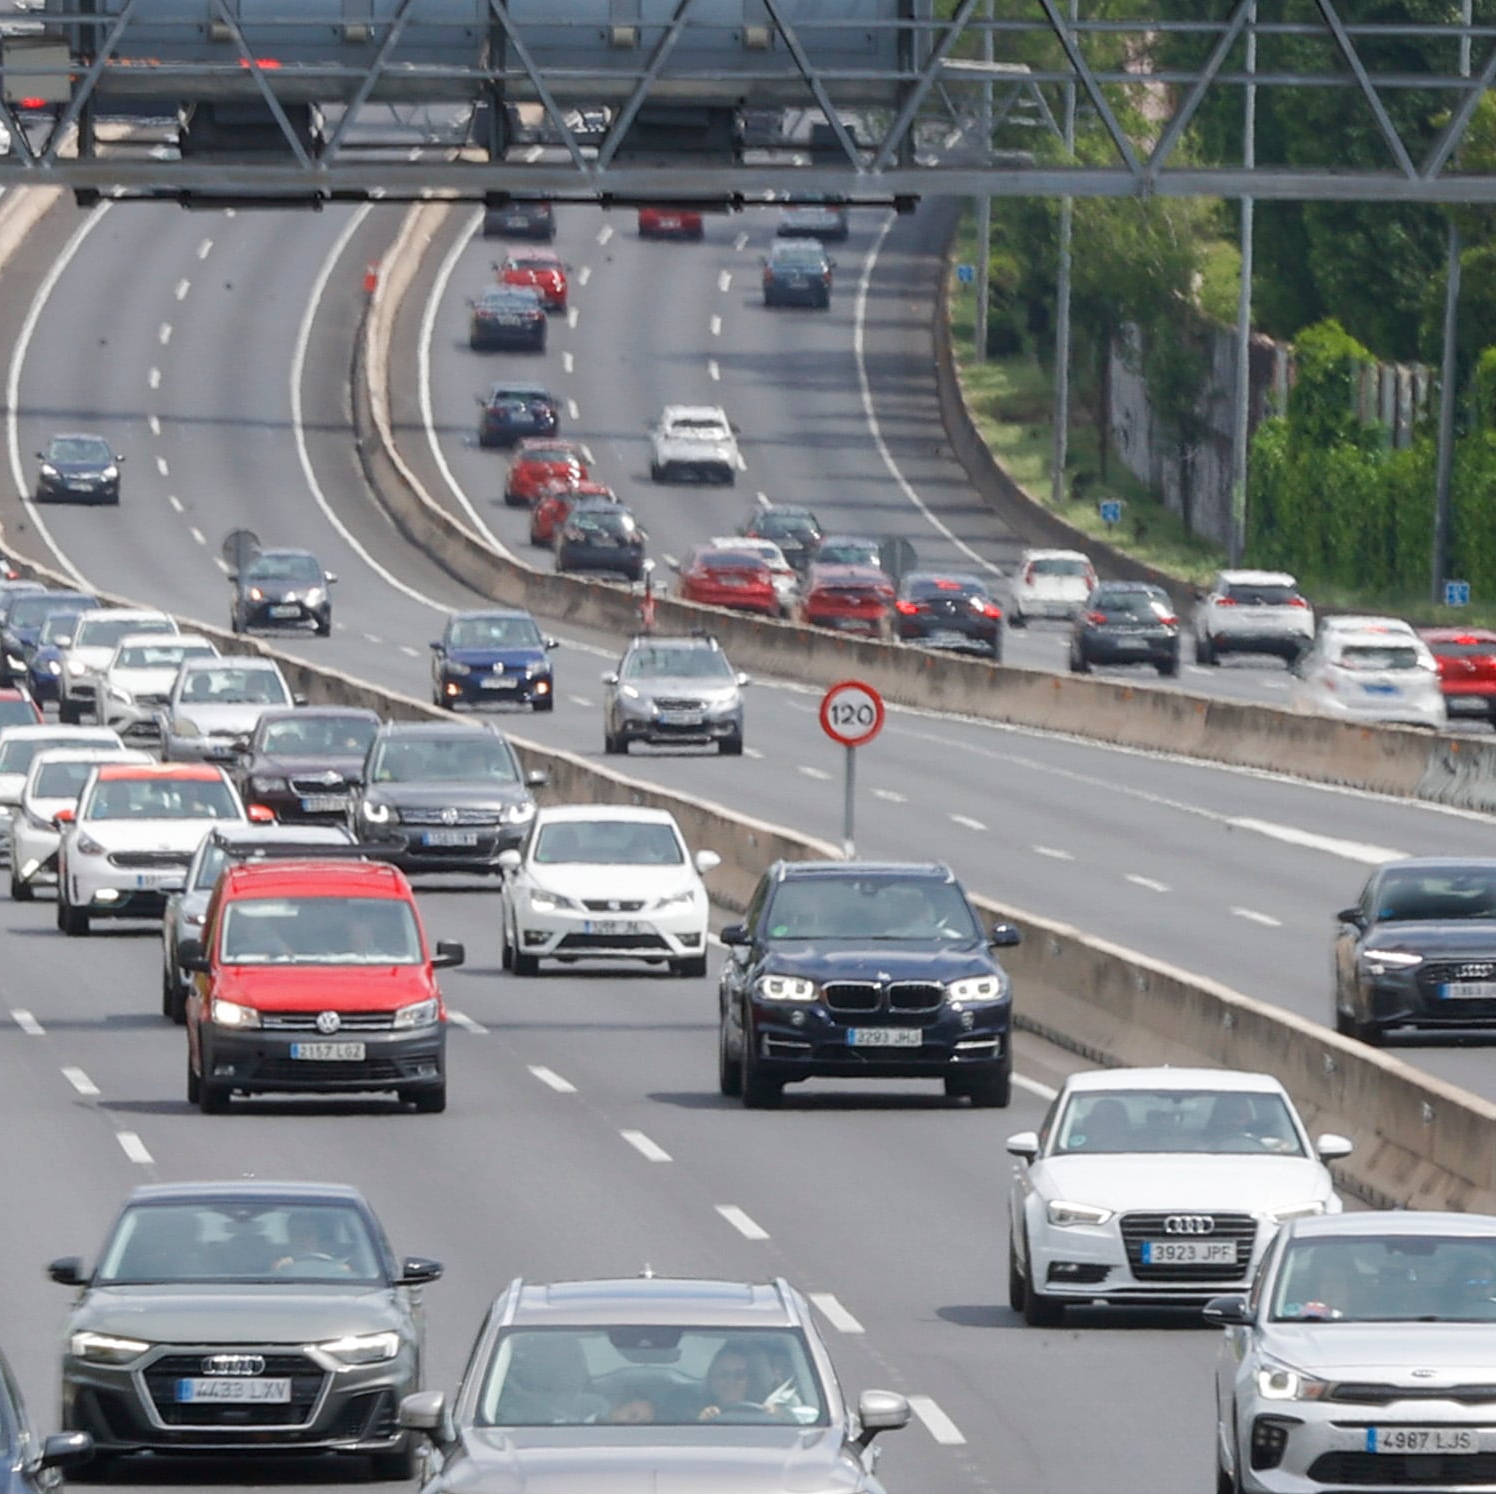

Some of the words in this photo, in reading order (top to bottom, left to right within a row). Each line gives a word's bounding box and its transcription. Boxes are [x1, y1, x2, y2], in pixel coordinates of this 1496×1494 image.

[831, 703, 875, 726] 120
[1155, 1244, 1197, 1261] 3923
[1199, 1244, 1232, 1261] JPF
[249, 1381, 288, 1399] LXV
[1383, 1431, 1429, 1450] 4987
[1436, 1431, 1472, 1450] LJS
